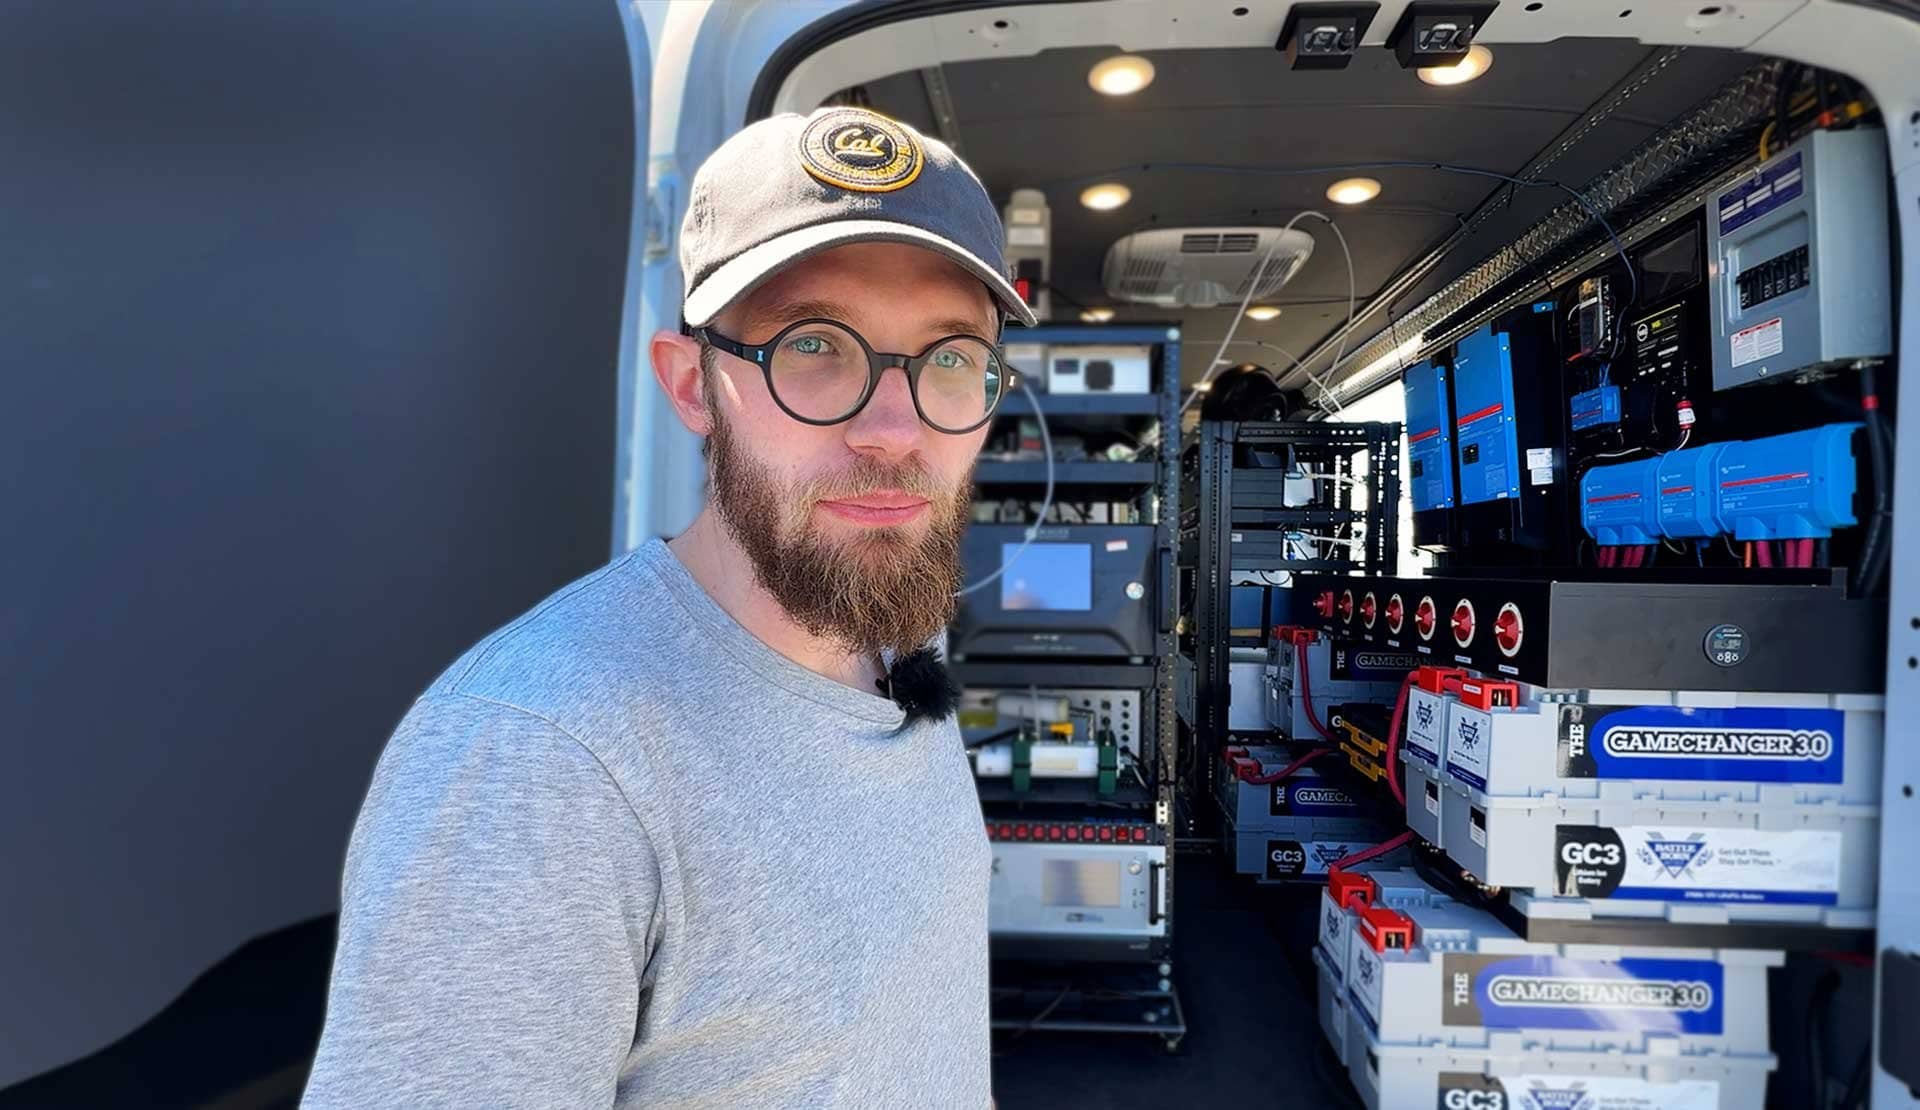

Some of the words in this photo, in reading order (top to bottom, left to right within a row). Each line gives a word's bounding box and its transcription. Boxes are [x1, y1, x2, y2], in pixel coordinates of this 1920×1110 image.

[834, 128, 886, 157] Cal
[1336, 650, 1345, 669] THE
[1569, 723, 1585, 758] THE
[1276, 786, 1286, 805] THE
[1271, 849, 1303, 863] GC3
[1561, 842, 1620, 865] GC3
[1453, 972, 1469, 1006] THE
[1445, 1088, 1503, 1110] GC3
